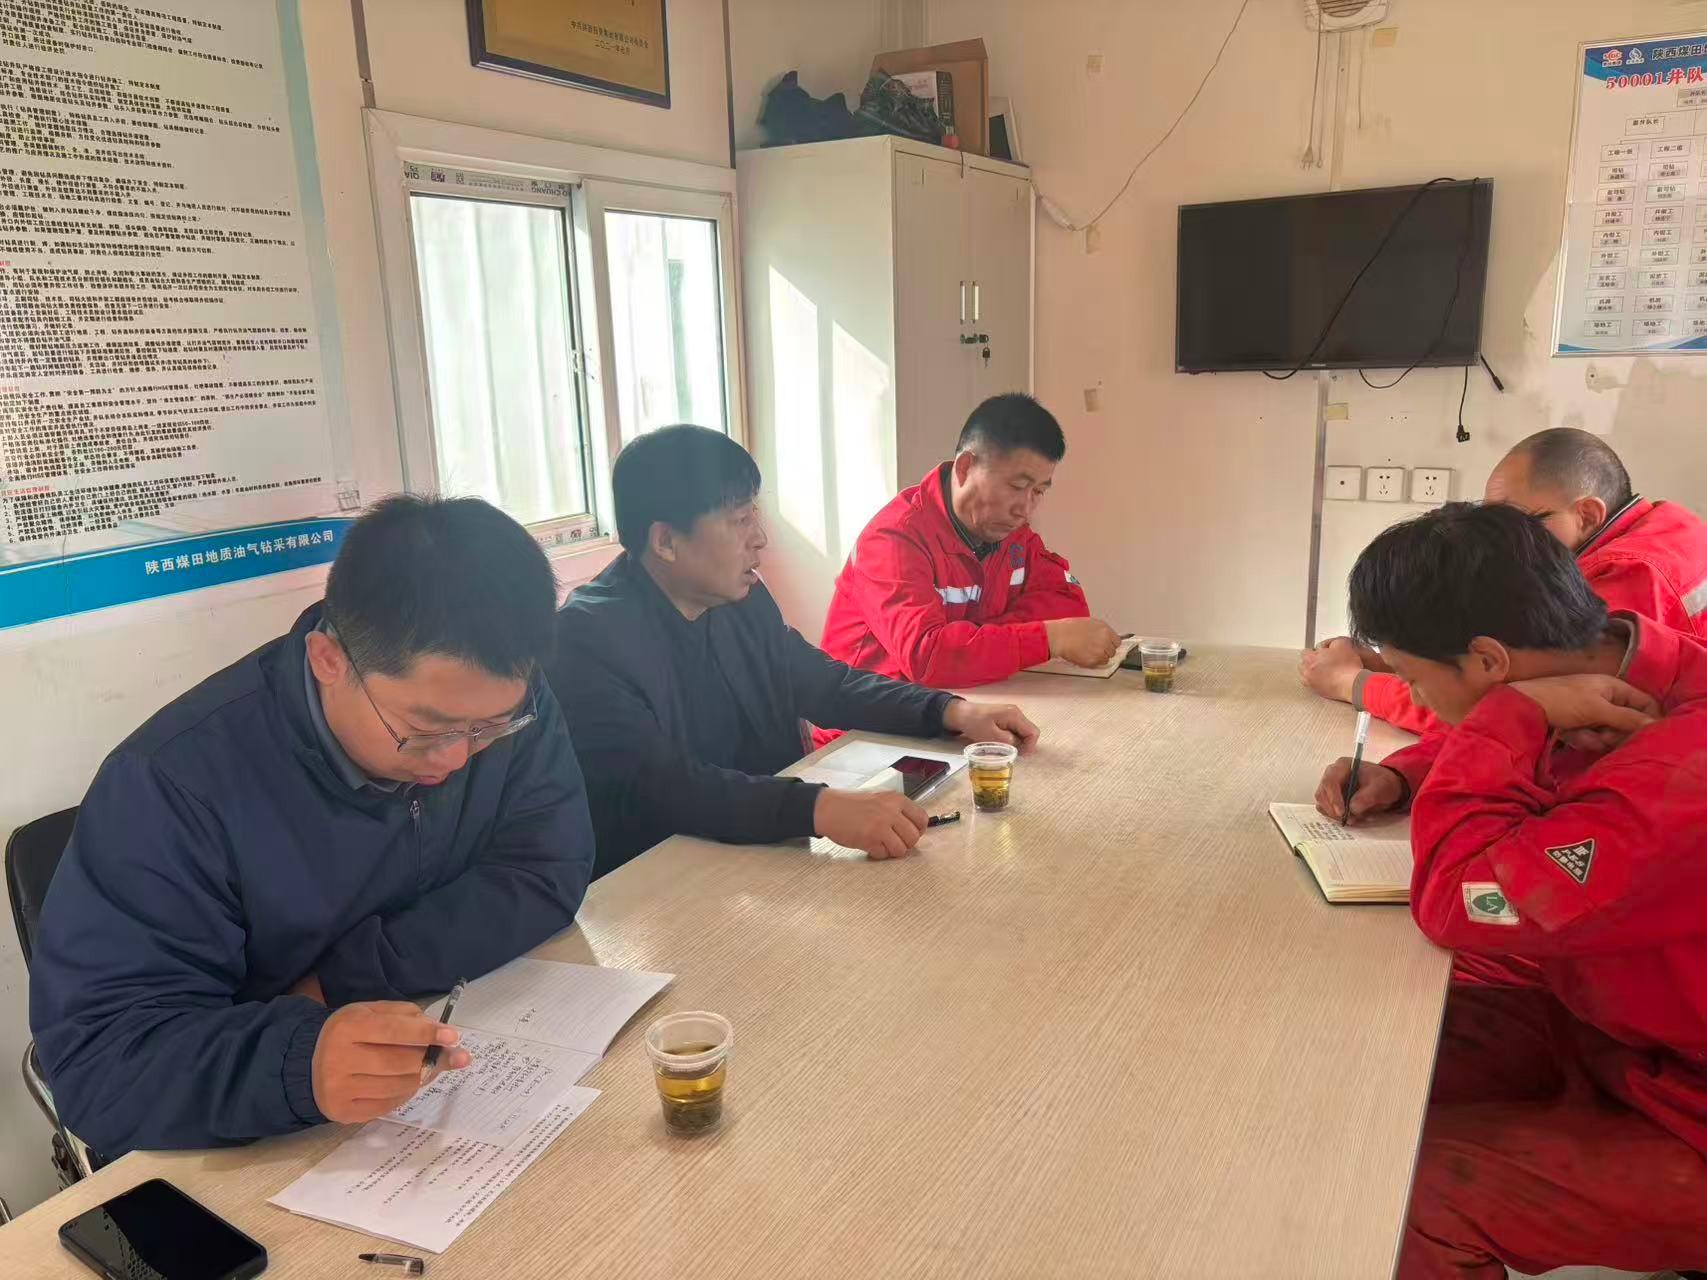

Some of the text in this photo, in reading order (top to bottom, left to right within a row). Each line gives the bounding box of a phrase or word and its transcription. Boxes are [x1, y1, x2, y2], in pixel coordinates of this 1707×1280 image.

[1605, 66, 1704, 90] 50001井队
[145, 529, 334, 575] 陕西煤田地质油气钻采有限公司
